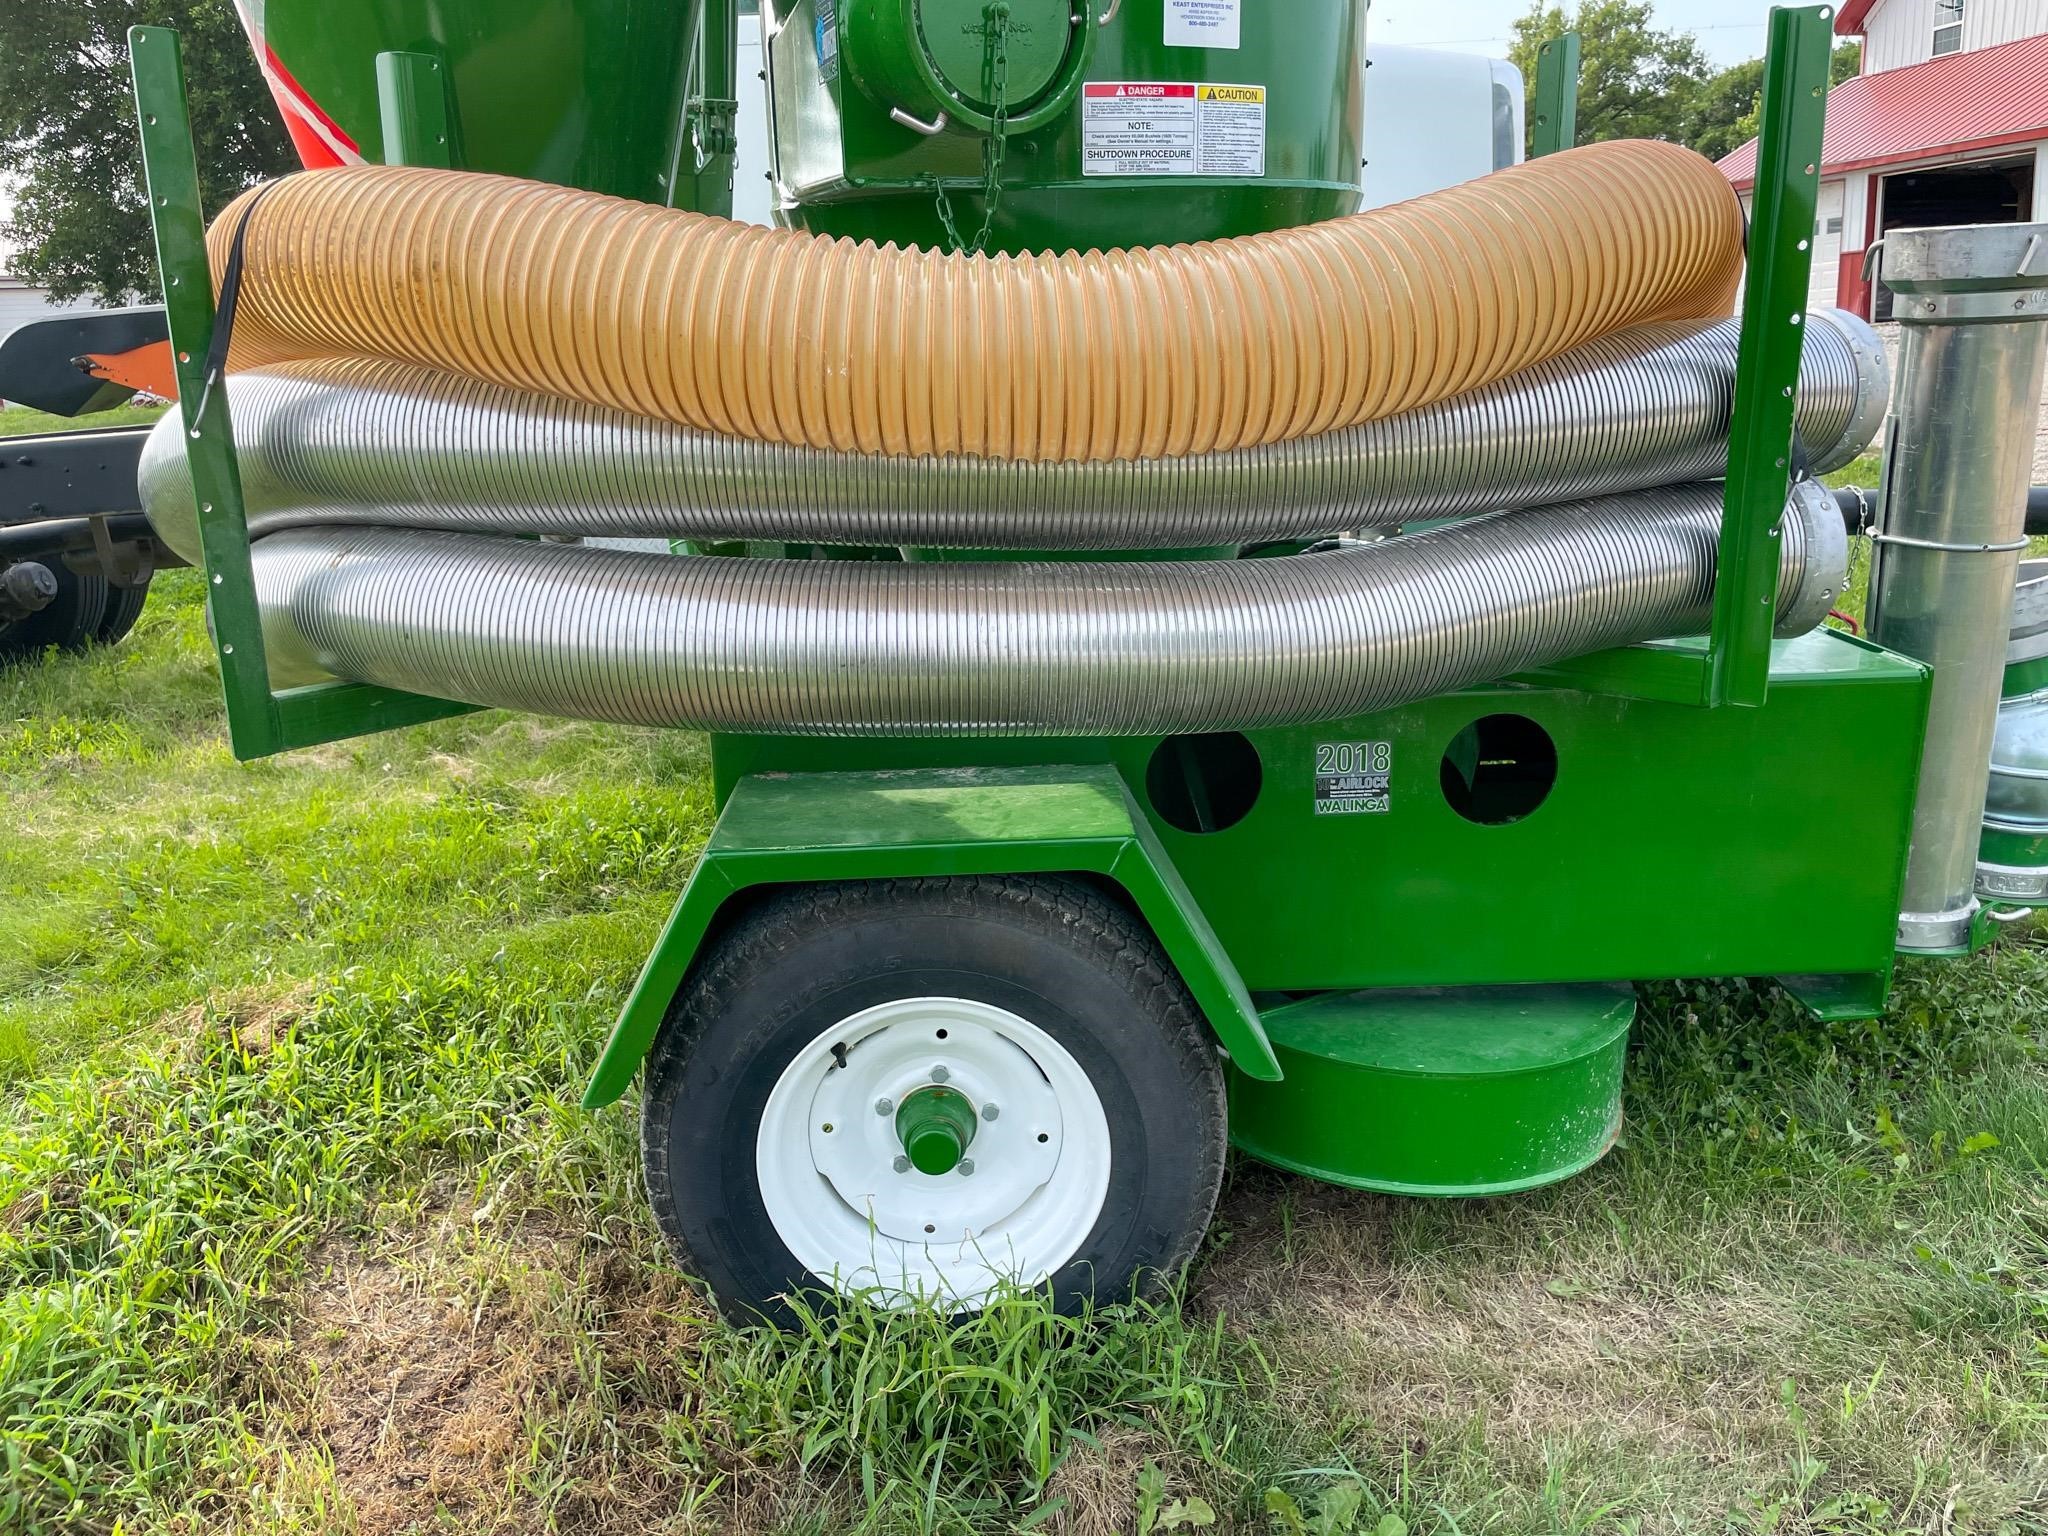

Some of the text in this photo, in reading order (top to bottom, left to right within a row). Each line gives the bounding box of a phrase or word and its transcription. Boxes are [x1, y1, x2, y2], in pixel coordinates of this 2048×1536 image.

[1128, 86, 1165, 96] DANGER
[1218, 89, 1258, 101] CAUTION
[1127, 121, 1154, 131] NOTE:
[1087, 150, 1192, 159] SHUTDOWN PROCEDURE
[1316, 742, 1390, 775] 2018
[1338, 776, 1389, 789] AIRLOCK
[1317, 798, 1388, 813] WALINGA
